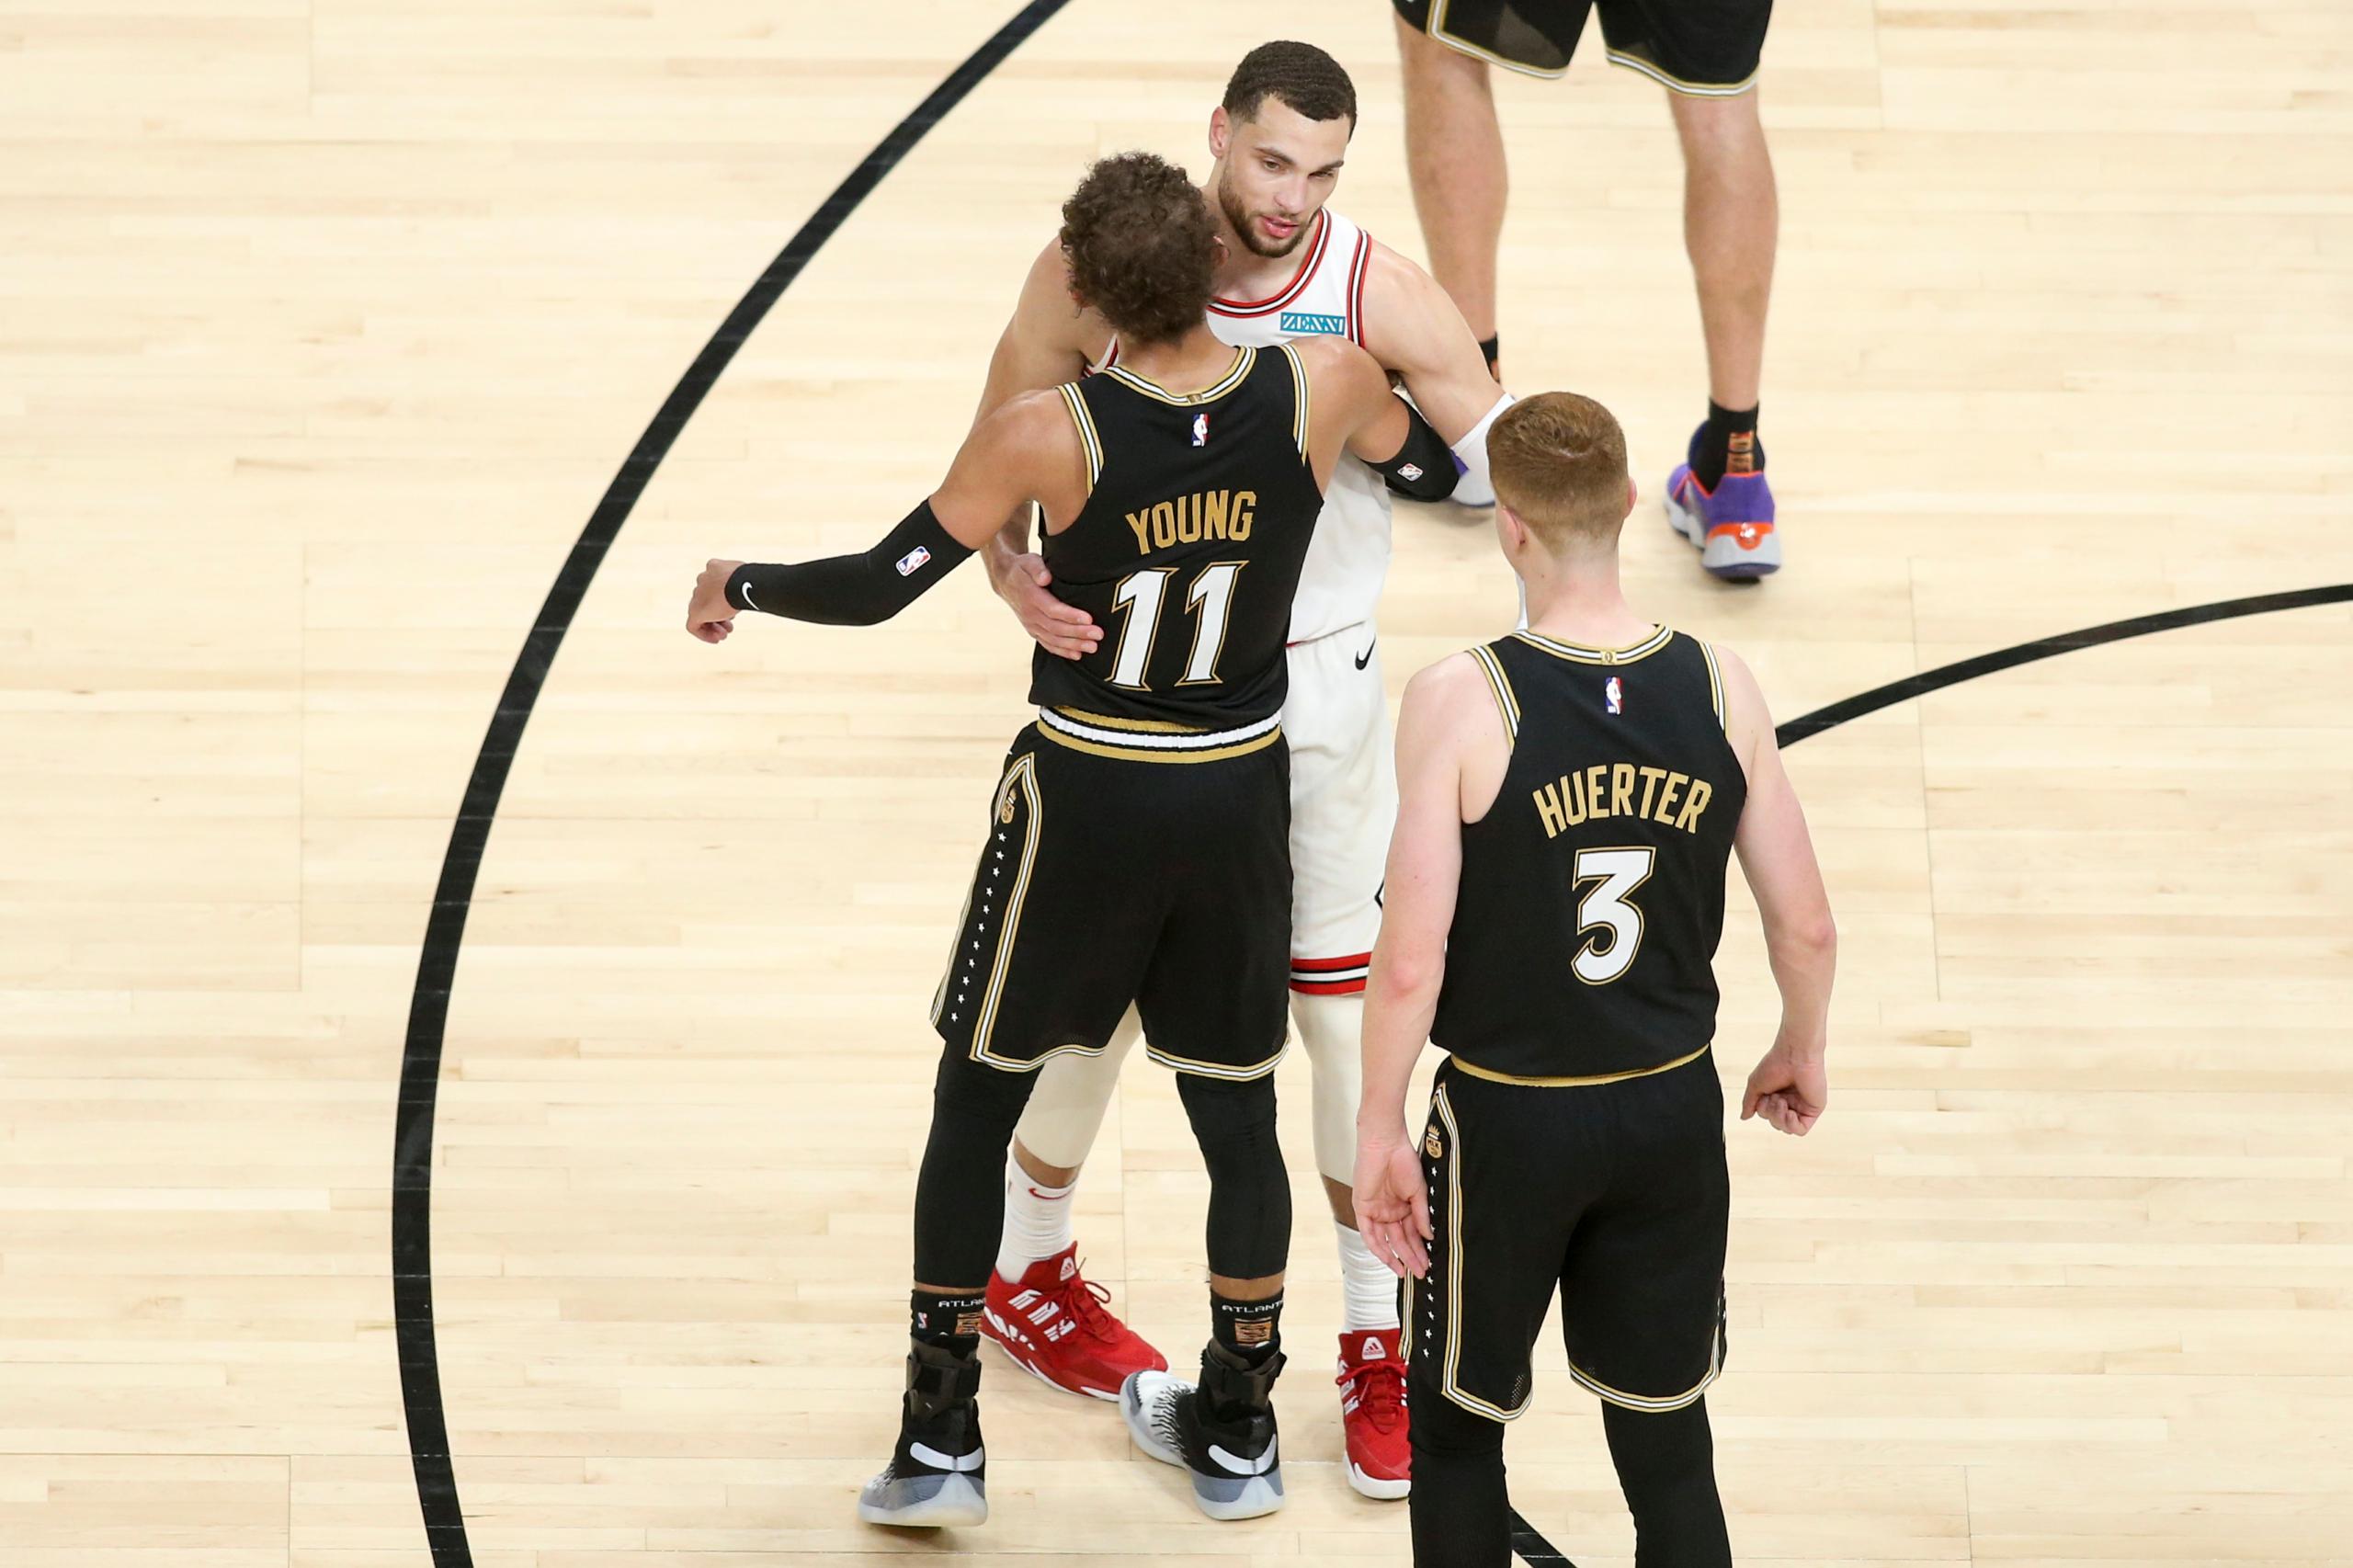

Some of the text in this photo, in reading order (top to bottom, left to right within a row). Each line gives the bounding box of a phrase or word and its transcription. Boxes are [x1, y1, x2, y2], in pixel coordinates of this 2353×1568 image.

[1282, 314, 1345, 333] ZENNI
[1125, 490, 1257, 555] YOUNG
[1105, 560, 1249, 691] 11
[1532, 763, 1712, 839] HUERTER
[1571, 846, 1656, 985] 3
